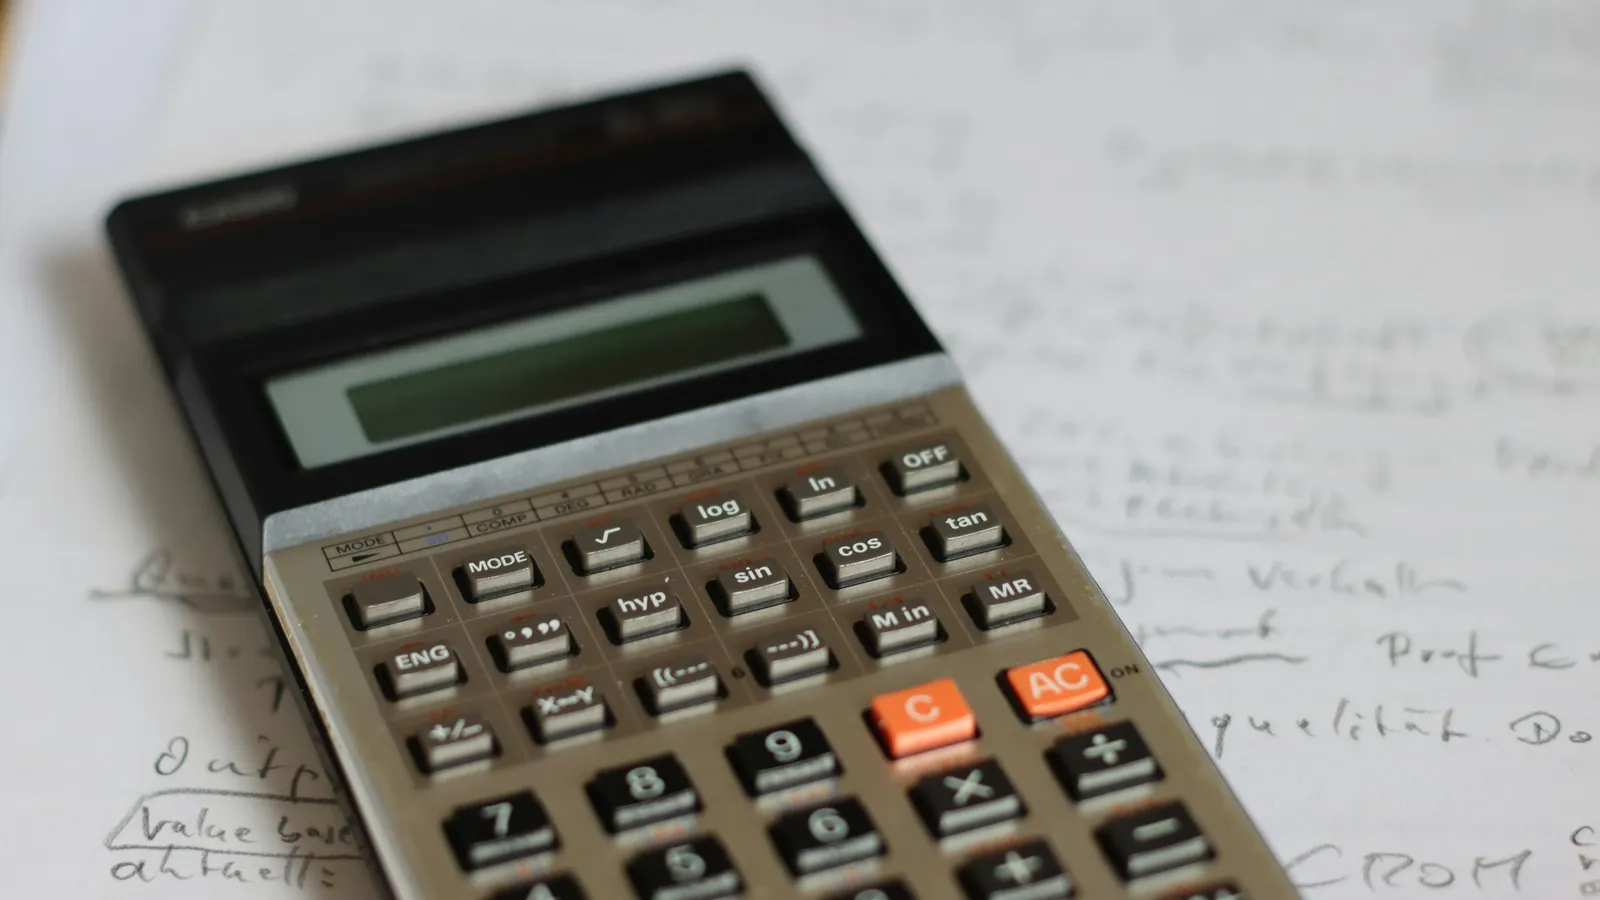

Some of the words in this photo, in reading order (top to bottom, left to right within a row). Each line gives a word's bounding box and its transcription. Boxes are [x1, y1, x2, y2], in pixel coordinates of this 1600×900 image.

[903, 444, 949, 470] OFF
[554, 498, 590, 514] DEG
[696, 498, 741, 520] log
[476, 513, 528, 533] COMP
[944, 510, 989, 531] tan
[335, 535, 387, 554] MODE
[838, 536, 883, 557] cos
[467, 550, 529, 574] MODE
[734, 564, 774, 584] sin
[988, 578, 1033, 600] MR
[616, 590, 668, 614] hyp
[394, 644, 451, 670] ENG
[1028, 662, 1090, 700] AC
[1110, 664, 1140, 681] ON
[903, 693, 941, 723] C
[764, 729, 803, 762] 9
[625, 766, 665, 800] 8
[480, 800, 513, 838] 7
[807, 806, 850, 844] 6
[664, 843, 707, 882] 5
